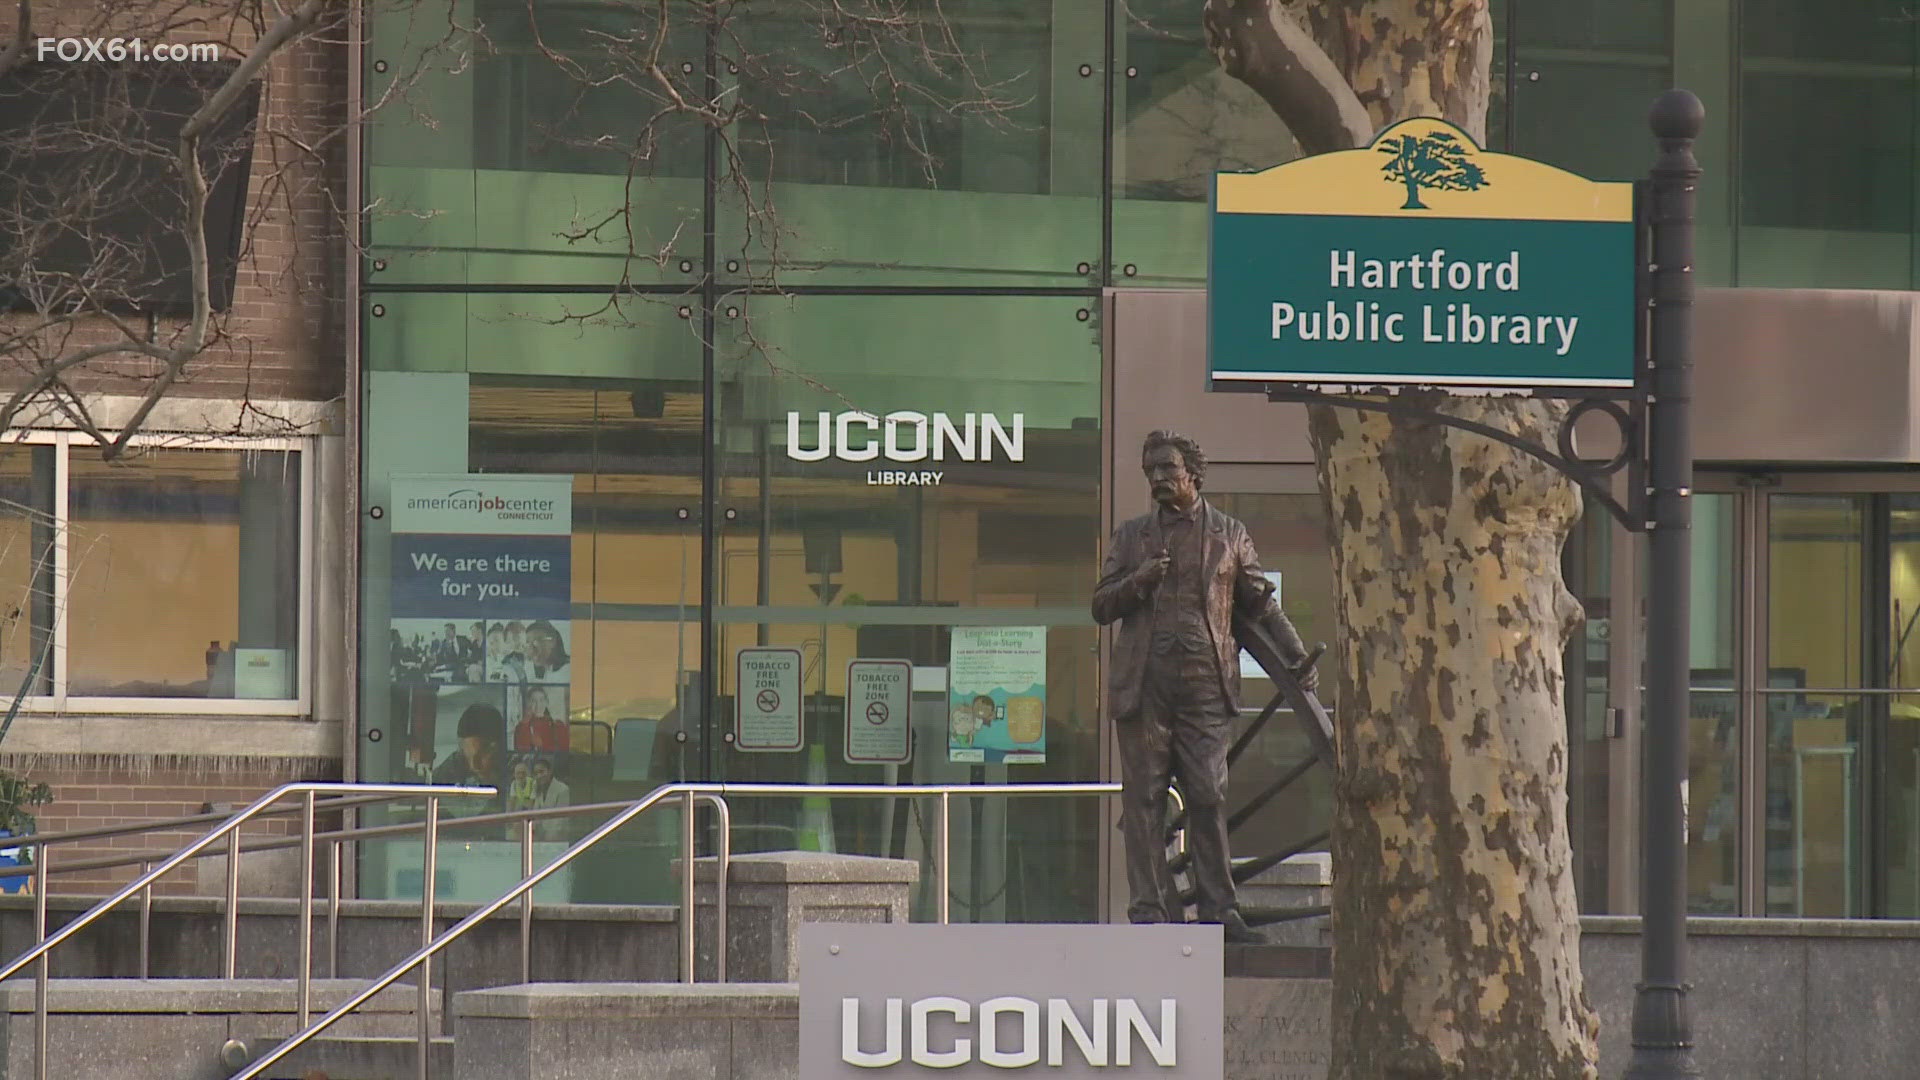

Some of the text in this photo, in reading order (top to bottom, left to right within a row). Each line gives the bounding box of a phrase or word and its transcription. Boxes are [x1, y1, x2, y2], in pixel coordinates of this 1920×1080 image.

[1329, 248, 1520, 291] Hartford
[1271, 300, 1579, 356] Public Library
[787, 410, 1024, 462] UCONN
[866, 471, 944, 486] LIBRARY
[497, 512, 553, 521] CONNECTICUT
[410, 552, 551, 573] We are there
[441, 578, 520, 601] for you.
[745, 661, 791, 671] TOBACCO
[756, 670, 779, 679] FREE
[856, 673, 900, 682] TOBACCO
[755, 679, 781, 688] ZONE
[866, 682, 888, 691] FREE
[865, 692, 890, 701] ZONE
[841, 996, 1177, 1068] UCONN
